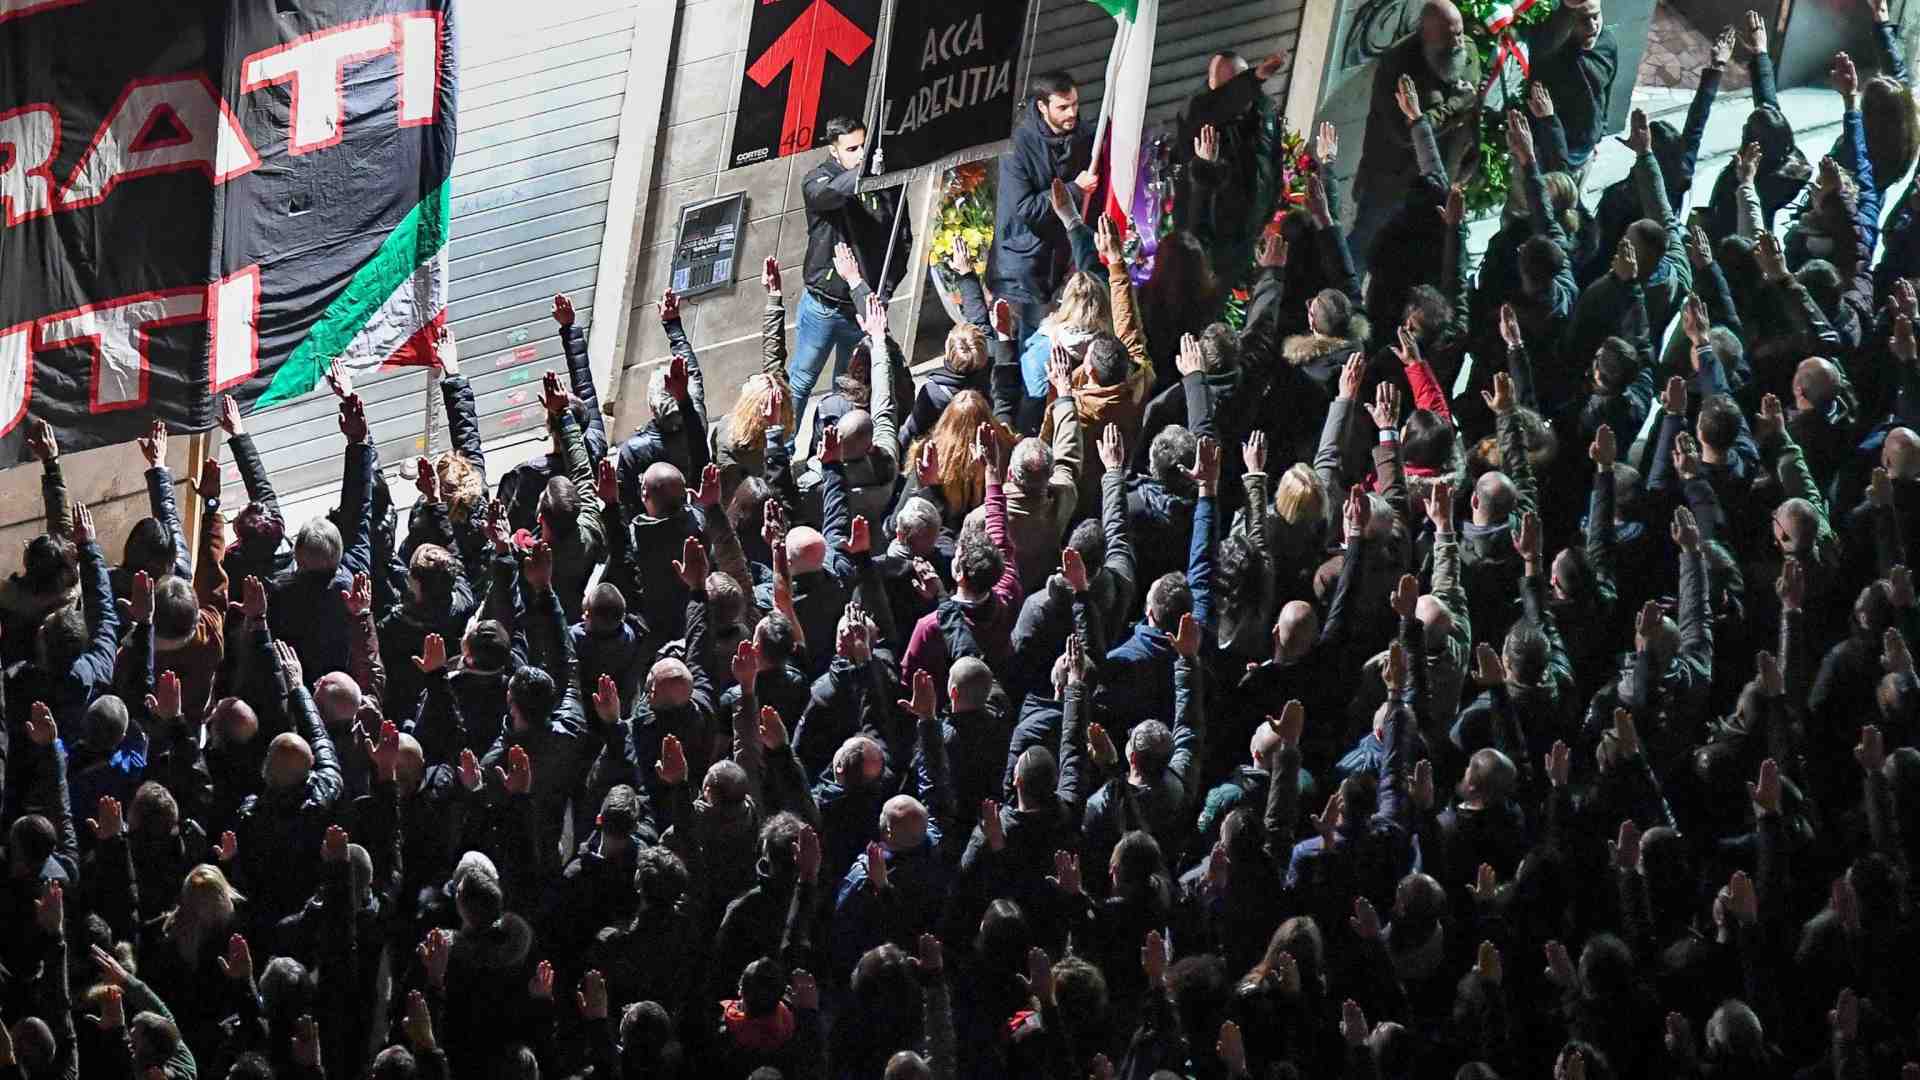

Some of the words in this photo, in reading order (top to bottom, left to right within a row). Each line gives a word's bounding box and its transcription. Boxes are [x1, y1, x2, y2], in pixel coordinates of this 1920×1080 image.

[920, 13, 985, 71] ACCA
[882, 59, 1011, 136] LARENTIA
[780, 126, 812, 149] 40
